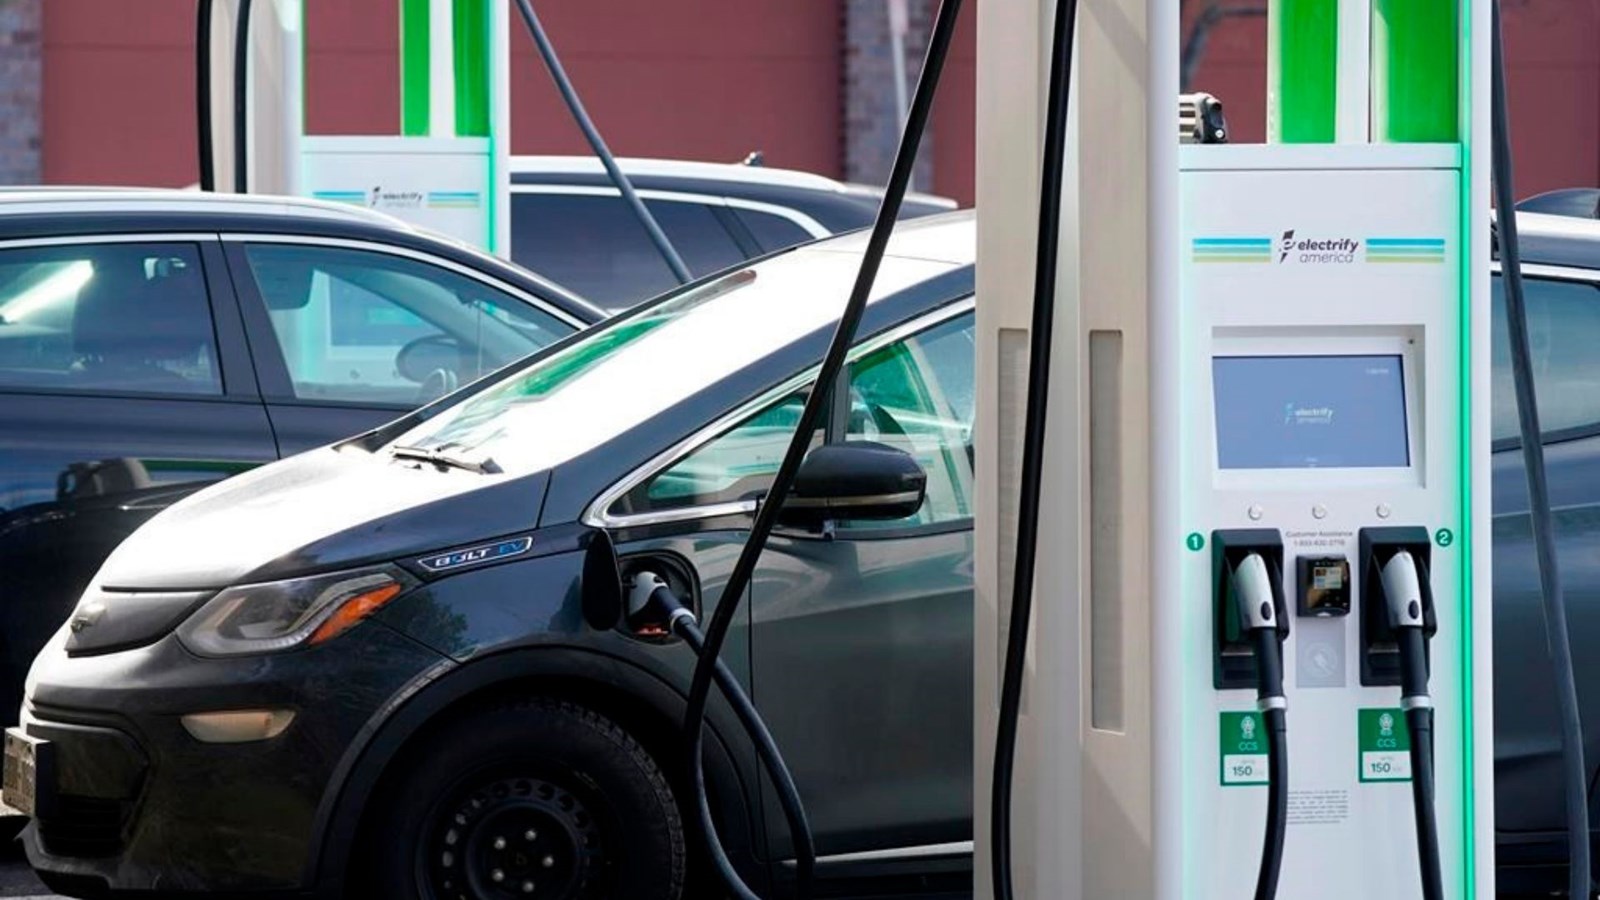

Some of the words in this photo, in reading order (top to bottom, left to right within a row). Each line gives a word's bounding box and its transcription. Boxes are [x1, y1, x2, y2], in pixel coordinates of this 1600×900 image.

[382, 192, 423, 201] electrify
[1298, 238, 1359, 253] electrify
[1299, 252, 1354, 263] america
[1294, 406, 1334, 419] electrify
[435, 548, 491, 567] BOLT
[499, 540, 524, 554] EV
[1238, 741, 1259, 751] CCS
[1376, 737, 1397, 748] CCS
[1232, 766, 1253, 776] 150
[1370, 762, 1391, 773] 150
